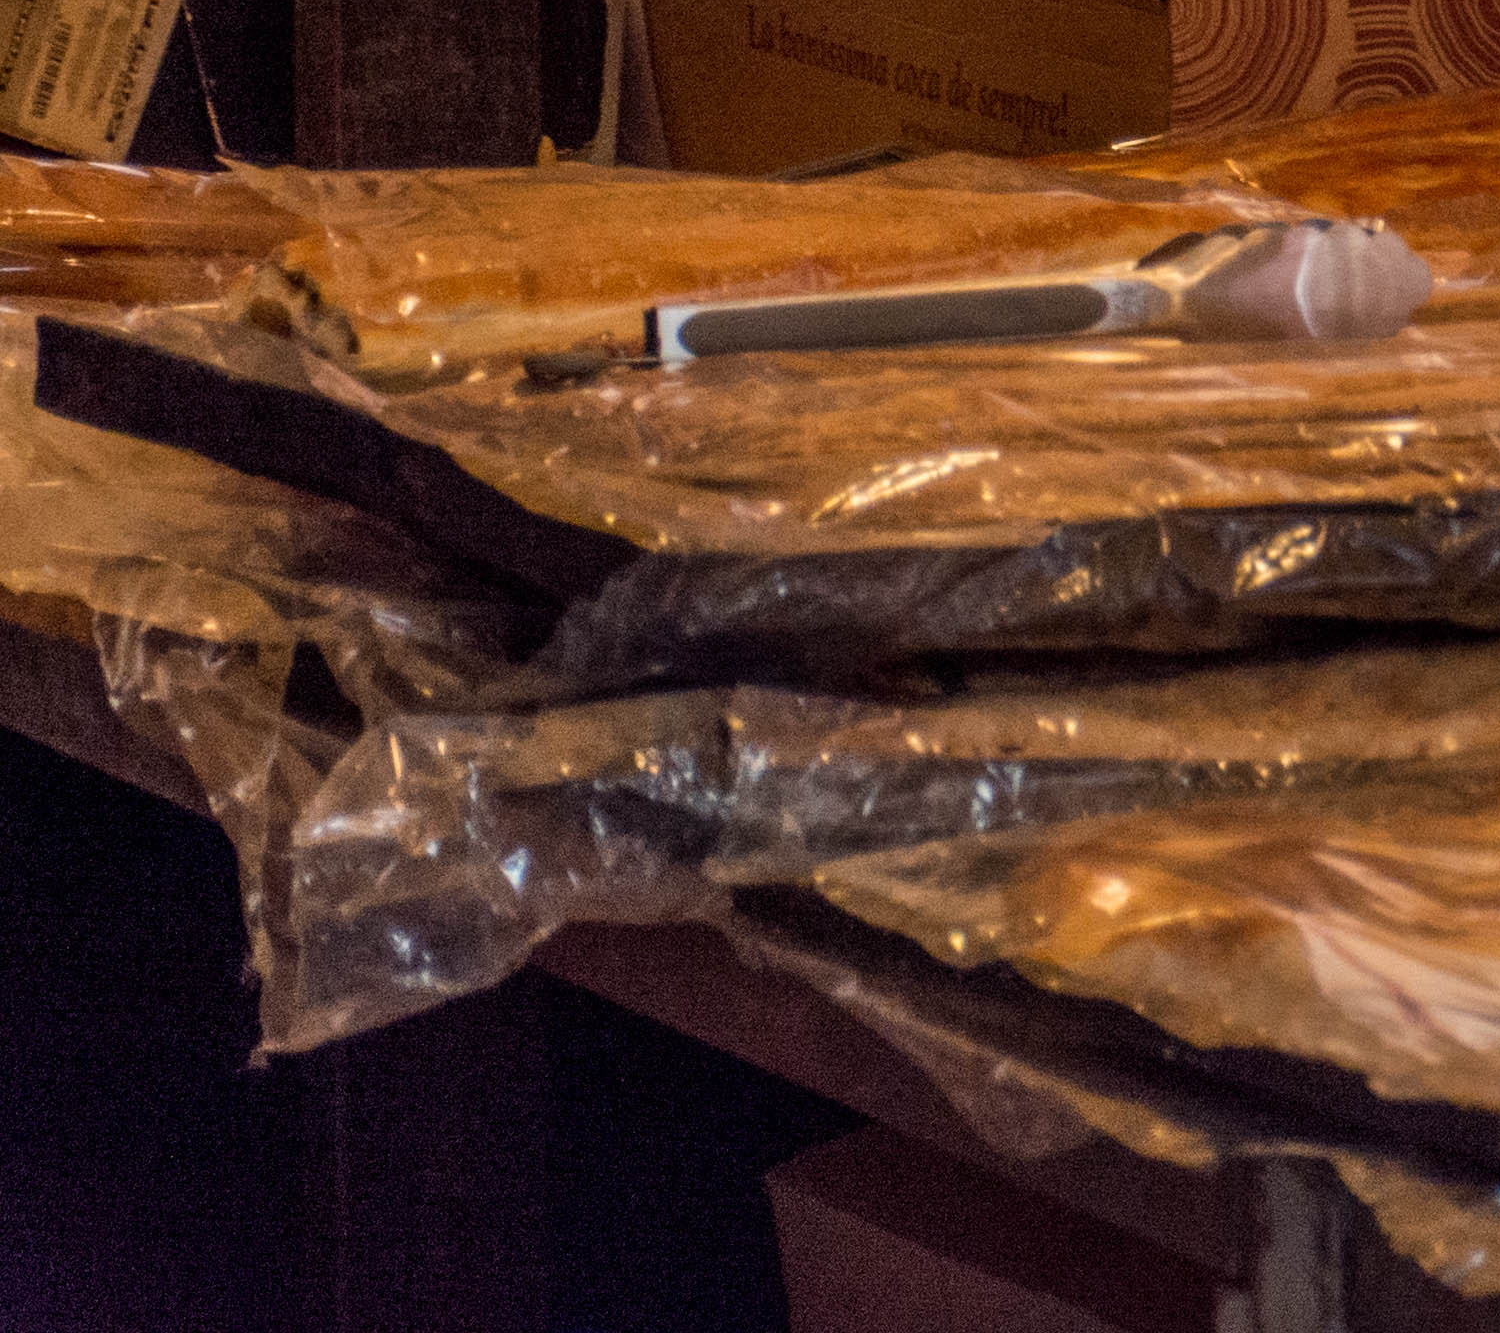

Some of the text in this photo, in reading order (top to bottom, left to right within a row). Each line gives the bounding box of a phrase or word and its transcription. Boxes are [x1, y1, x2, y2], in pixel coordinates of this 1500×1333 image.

[746, 4, 776, 53] La
[893, 61, 942, 103] coca
[946, 59, 973, 112] de
[976, 92, 1070, 145] sempre!
